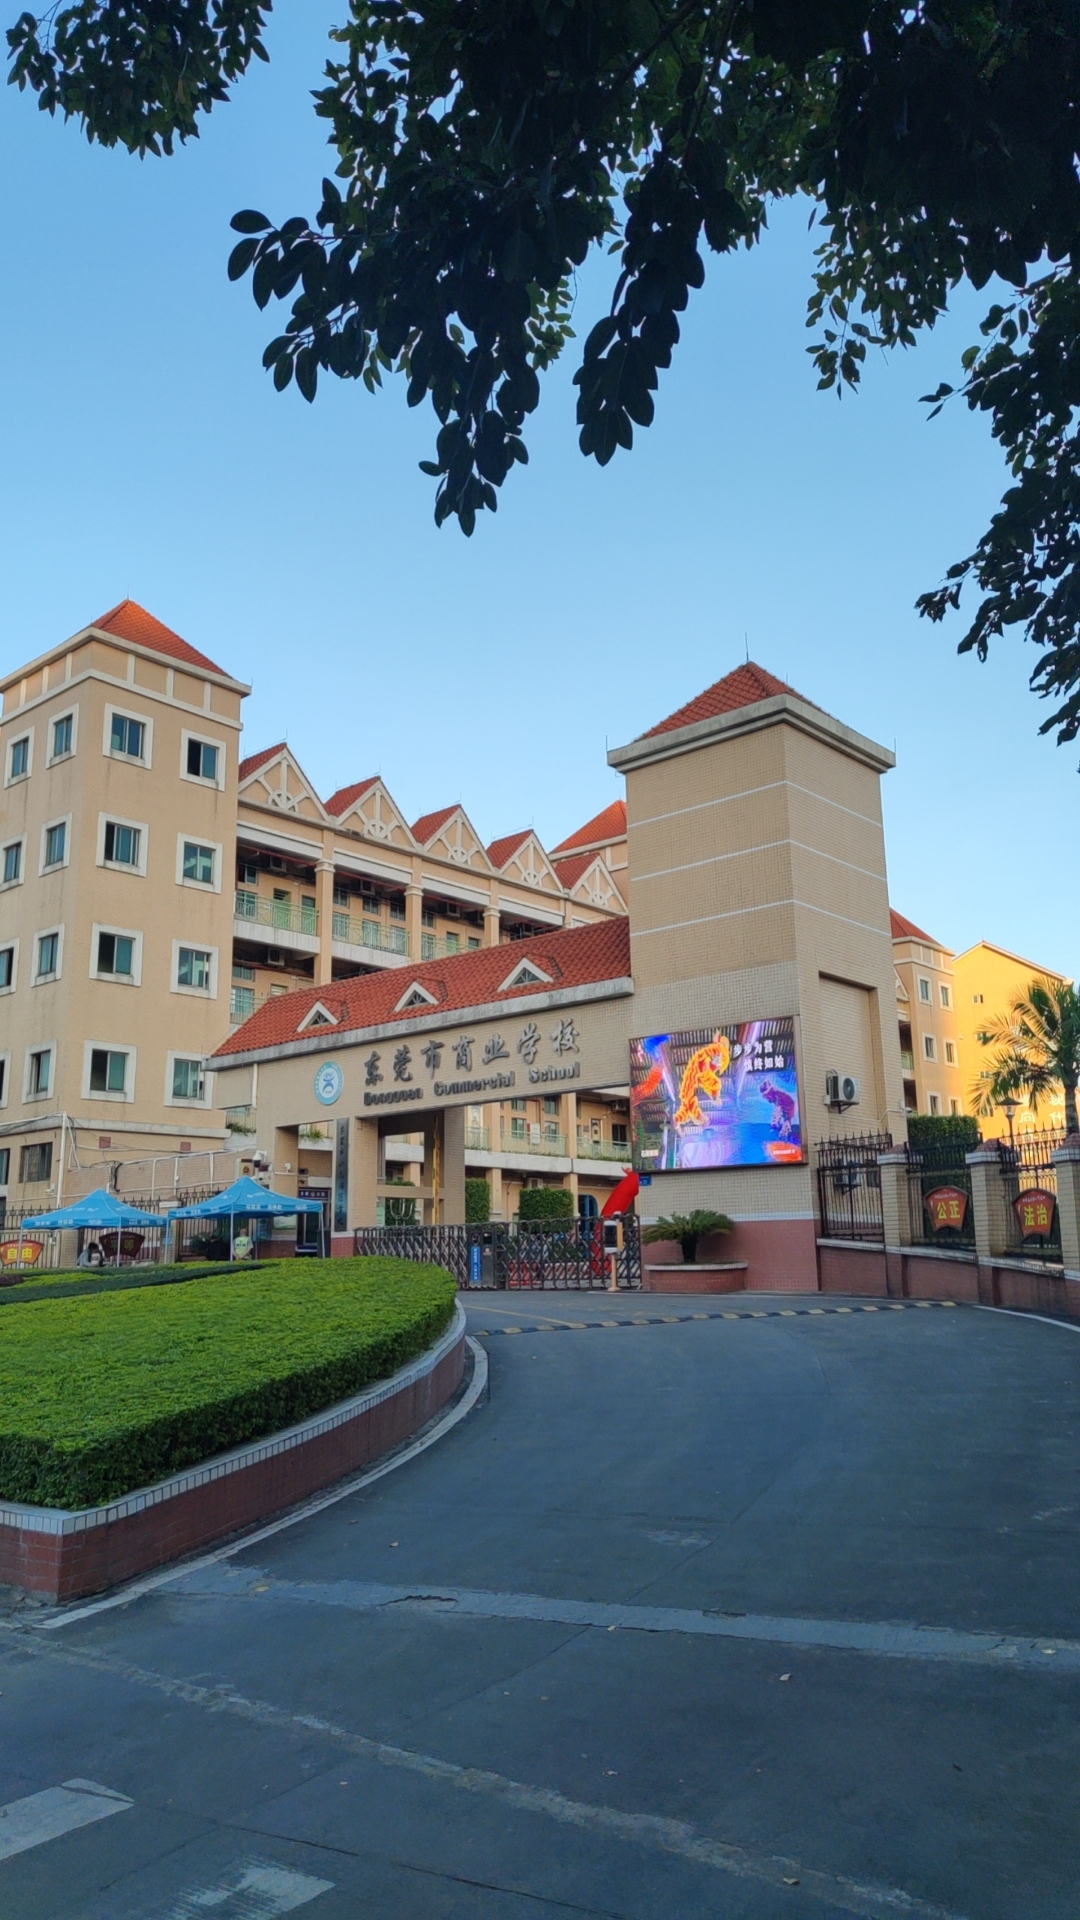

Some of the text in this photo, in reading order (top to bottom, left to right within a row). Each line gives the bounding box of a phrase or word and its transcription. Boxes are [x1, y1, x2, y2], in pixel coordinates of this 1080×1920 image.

[363, 1017, 580, 1087] 东莞市商业学校
[733, 1039, 773, 1059] 步步为营
[744, 1054, 784, 1072] 慎终如始
[434, 1071, 515, 1097] Commercial
[528, 1061, 580, 1084] School
[937, 1201, 961, 1219] 公正
[1024, 1204, 1048, 1226] 法治
[7, 1247, 33, 1259] 自由
